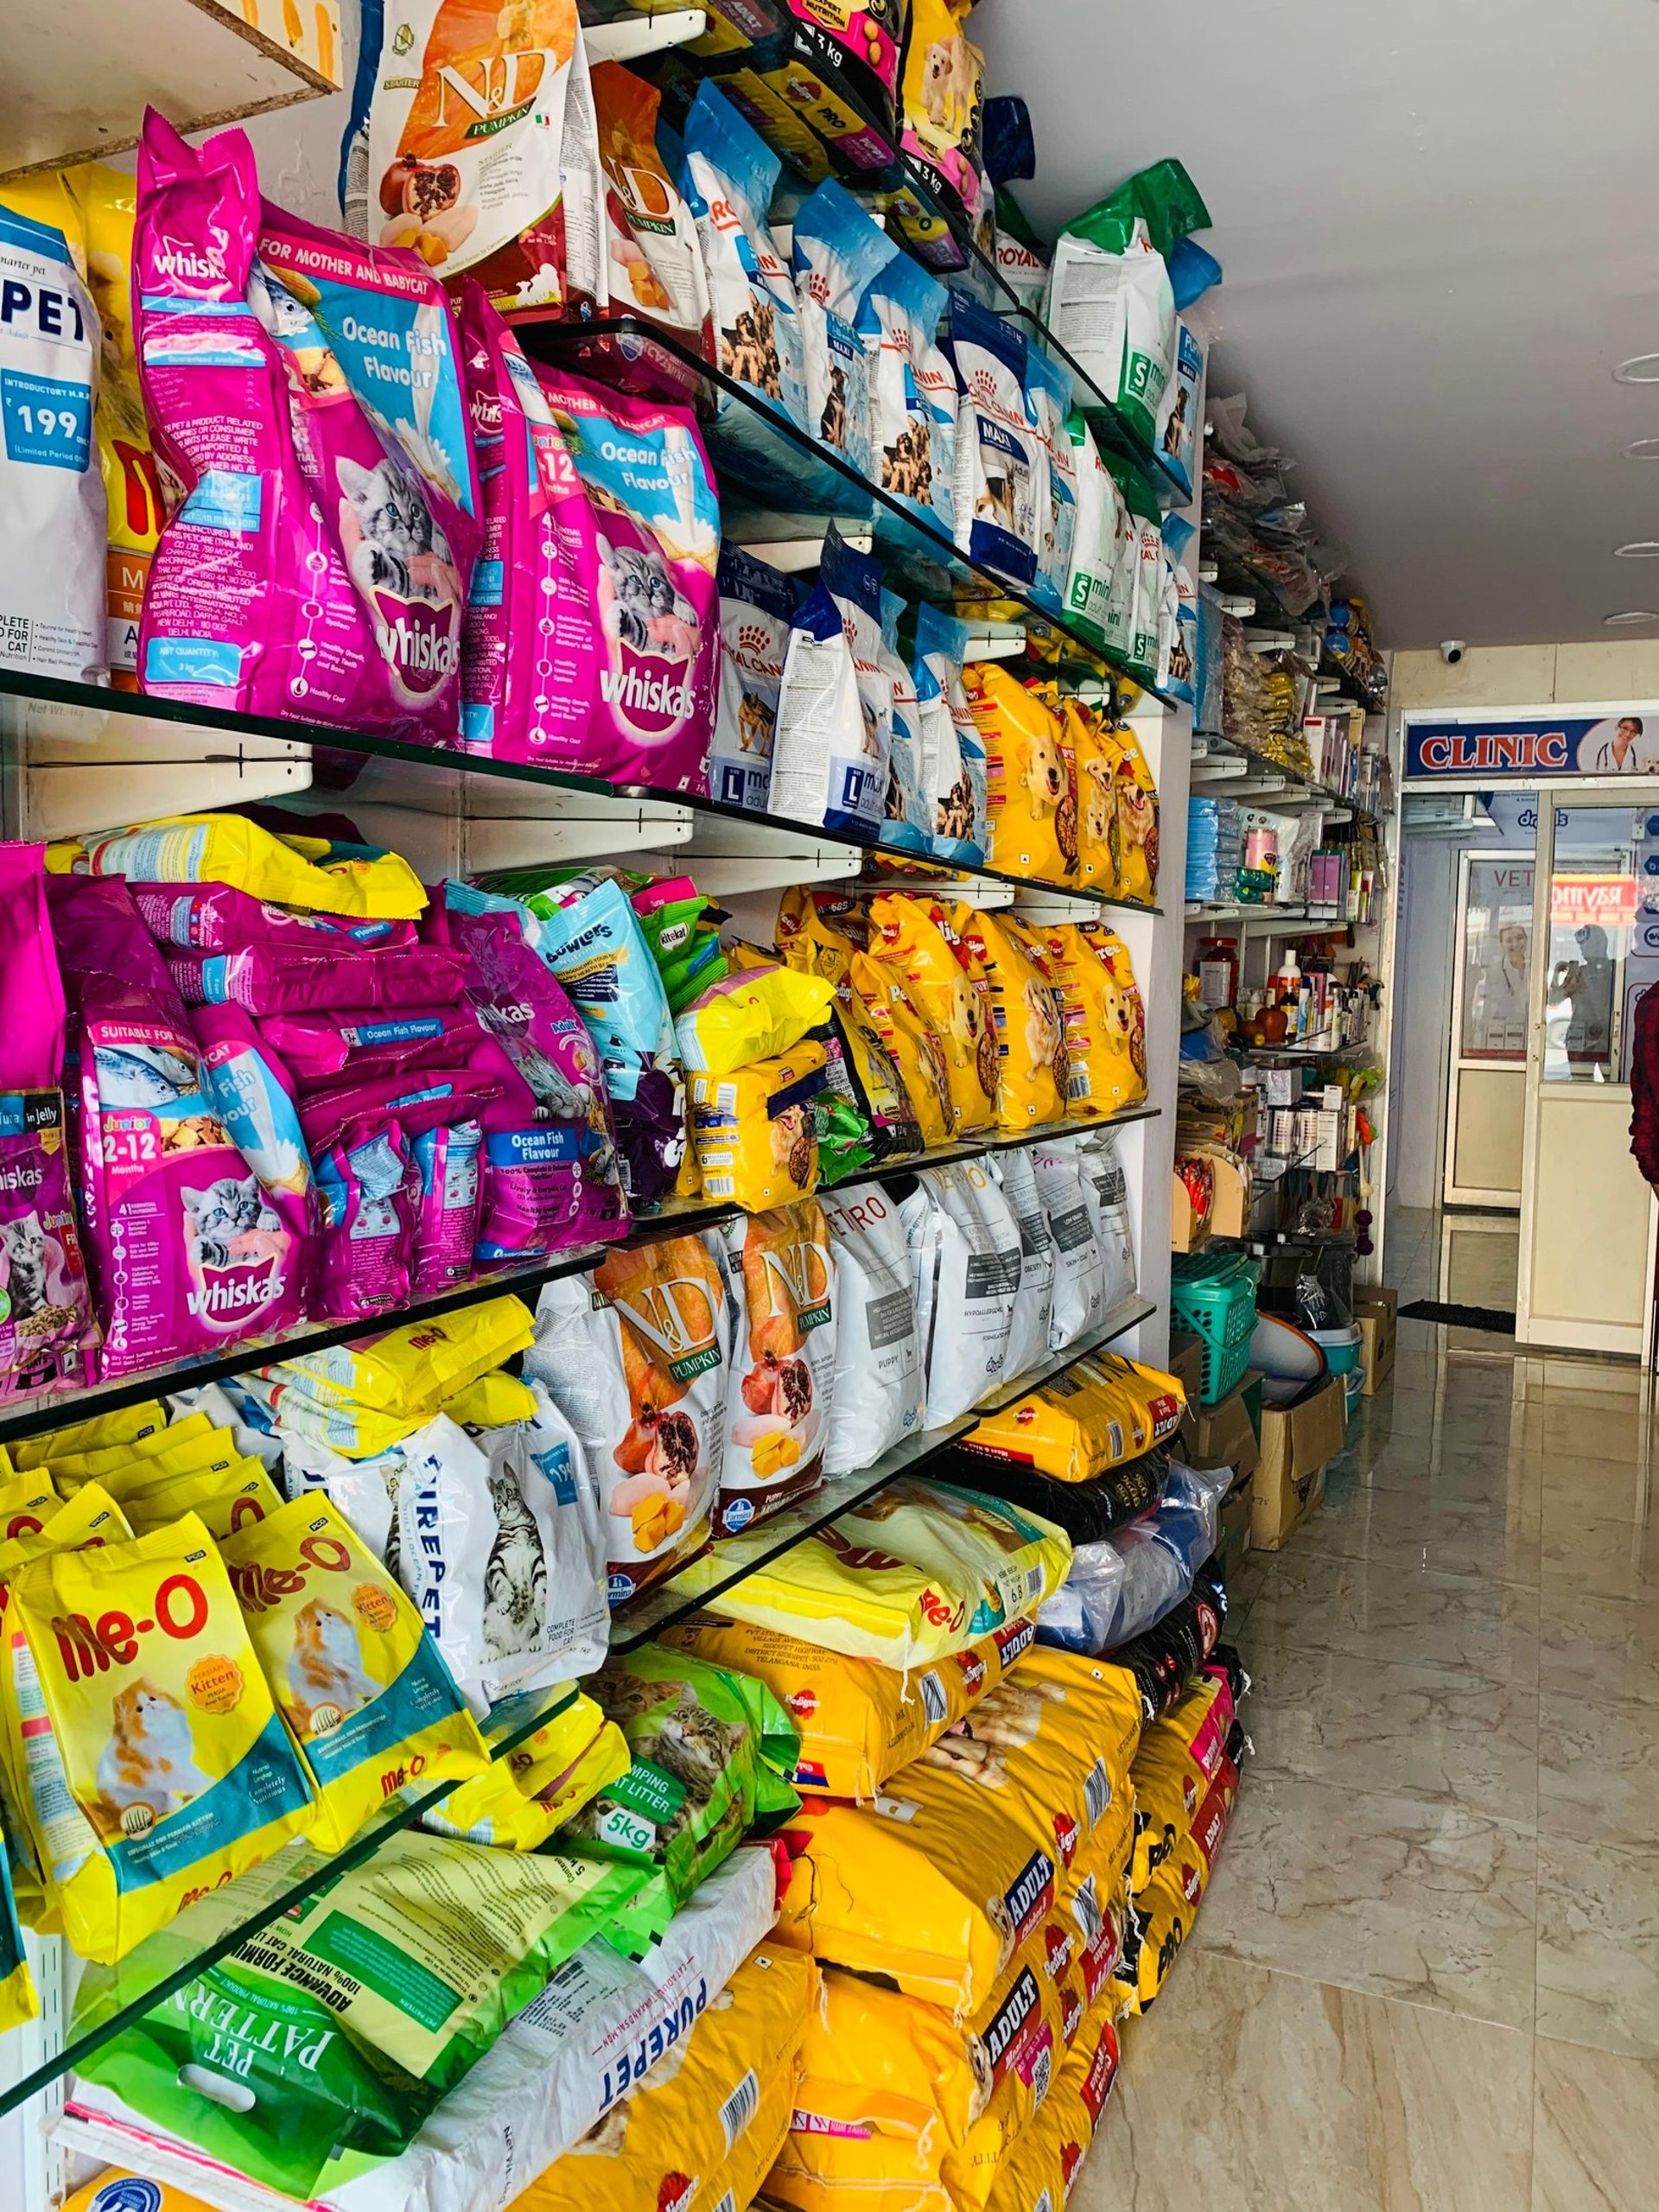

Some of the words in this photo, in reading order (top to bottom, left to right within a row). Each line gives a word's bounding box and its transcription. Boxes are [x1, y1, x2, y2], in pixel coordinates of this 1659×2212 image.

[817, 34, 824, 50] 3
[827, 42, 843, 67] kg
[384, 77, 421, 90] STARTER
[473, 107, 531, 136] PUMPKIN
[817, 106, 847, 129] PRO
[859, 137, 887, 161] PUPPY
[922, 166, 930, 180] 3
[930, 173, 944, 194] kg
[29, 266, 46, 276] pet
[258, 238, 292, 259] FOR
[294, 249, 353, 277] MOTHER
[355, 264, 383, 284] AND
[383, 272, 429, 296] BABYCAT
[342, 316, 401, 351] Ocean
[405, 327, 448, 357] Fish
[363, 356, 433, 389] Flavour
[4, 378, 67, 397] INTRODUCTORY
[548, 391, 596, 412] MOTHER
[17, 404, 78, 439] 199
[191, 416, 226, 427] PRODUCT
[226, 417, 264, 430] RELATED
[209, 423, 256, 438] CONSUMER
[201, 433, 232, 443] PLEASE
[232, 435, 259, 447] WRITE
[982, 422, 1012, 448] MAXI
[48, 450, 73, 462] Period
[200, 443, 241, 455] IMPORTED
[215, 452, 256, 465] ADDRESS
[601, 442, 657, 467] Ocean
[660, 448, 696, 467] Fish
[622, 471, 690, 493] Flavour
[174, 521, 228, 538] MANUFACTURED
[182, 531, 214, 545] PETCARE
[173, 619, 194, 628] DELHI
[8, 628, 29, 641] FOR
[8, 641, 29, 653] CAT
[600, 668, 696, 720] whiskas
[1420, 733, 1567, 771] CLINIC
[728, 774, 739, 800] L
[849, 776, 857, 801] L
[355, 923, 385, 938] Flavour
[661, 926, 686, 946] kitekat
[100, 1026, 153, 1040] SUITABLE
[154, 1028, 175, 1042] FOR
[366, 1027, 392, 1039] Ocean
[393, 1025, 409, 1036] Fish
[410, 1022, 437, 1035] Flavour
[552, 1019, 577, 1033] Adult
[218, 1068, 257, 1098] Fish
[27, 1113, 35, 1122] in
[35, 1106, 57, 1125] Jelly
[103, 1116, 153, 1133] Junior
[103, 1134, 158, 1164] 2-12
[512, 1134, 545, 1148] Ocean
[547, 1132, 564, 1145] Fish
[522, 1147, 560, 1161] Flavour
[111, 1163, 145, 1175] Months
[187, 1274, 287, 1316] whiskas
[672, 1346, 721, 1379] PUMPKIN
[878, 1355, 899, 1370] PUPPY
[138, 1426, 155, 1438] PCG
[211, 1461, 229, 1471] PCG
[309, 1517, 328, 1531] PCG
[725, 1510, 753, 1522] Farmina
[184, 1550, 206, 1562] PCG
[357, 1596, 389, 1613] Kitten
[1011, 1585, 1024, 1604] 6.8
[546, 1618, 575, 1637] COMPLETE
[547, 1631, 563, 1641] FOOD
[563, 1627, 575, 1638] FOR
[563, 1636, 574, 1646] CAT
[1001, 1624, 1035, 1666] ADULT
[745, 1648, 777, 1656] DISTRICT
[191, 1670, 235, 1695] Kitten
[249, 1776, 287, 1799] Completely
[627, 1784, 671, 1814] LITTER
[607, 1812, 652, 1850] 5kg
[1205, 1813, 1223, 1850] ADULT
[555, 1857, 575, 1885] Content
[575, 1865, 586, 1877] 5
[1008, 1853, 1052, 1926] ADULT
[264, 1935, 287, 1952] CAT
[1158, 1916, 1183, 1986] PRO
[286, 1947, 334, 1978] NATURAL
[219, 1978, 249, 1999] PRODUCT
[281, 1963, 354, 2014] ADVANCE
[334, 1969, 362, 1996] 100%
[250, 1993, 278, 2011] NATURAL
[162, 1976, 338, 2072] PATTERN
[989, 1972, 1037, 2064] ADULT
[599, 1977, 707, 2113] PUREPET
[204, 2032, 257, 2079] PET
